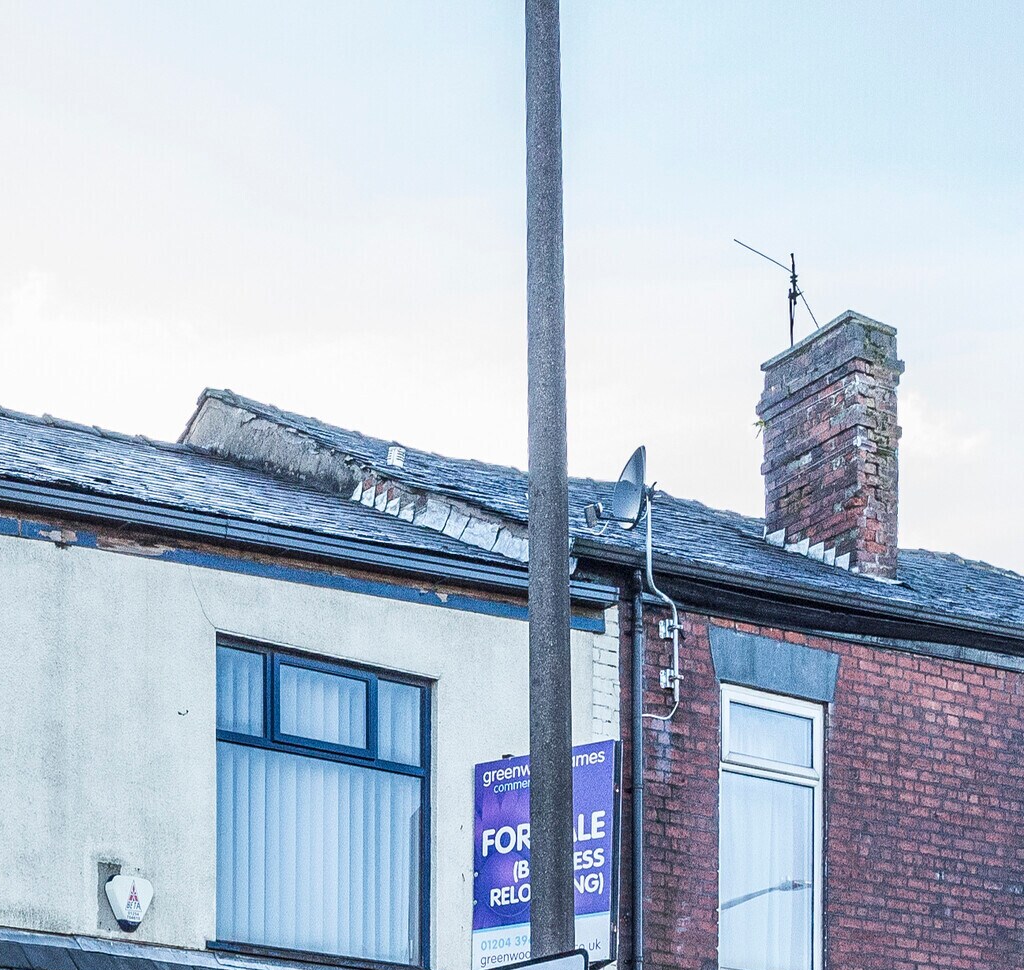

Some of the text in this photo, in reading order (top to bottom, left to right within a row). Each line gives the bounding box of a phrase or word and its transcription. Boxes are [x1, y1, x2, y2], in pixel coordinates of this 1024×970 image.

[482, 764, 530, 788] greenw
[493, 779, 530, 794] commer
[482, 823, 531, 857] FOR
[480, 937, 512, 951] 01204
